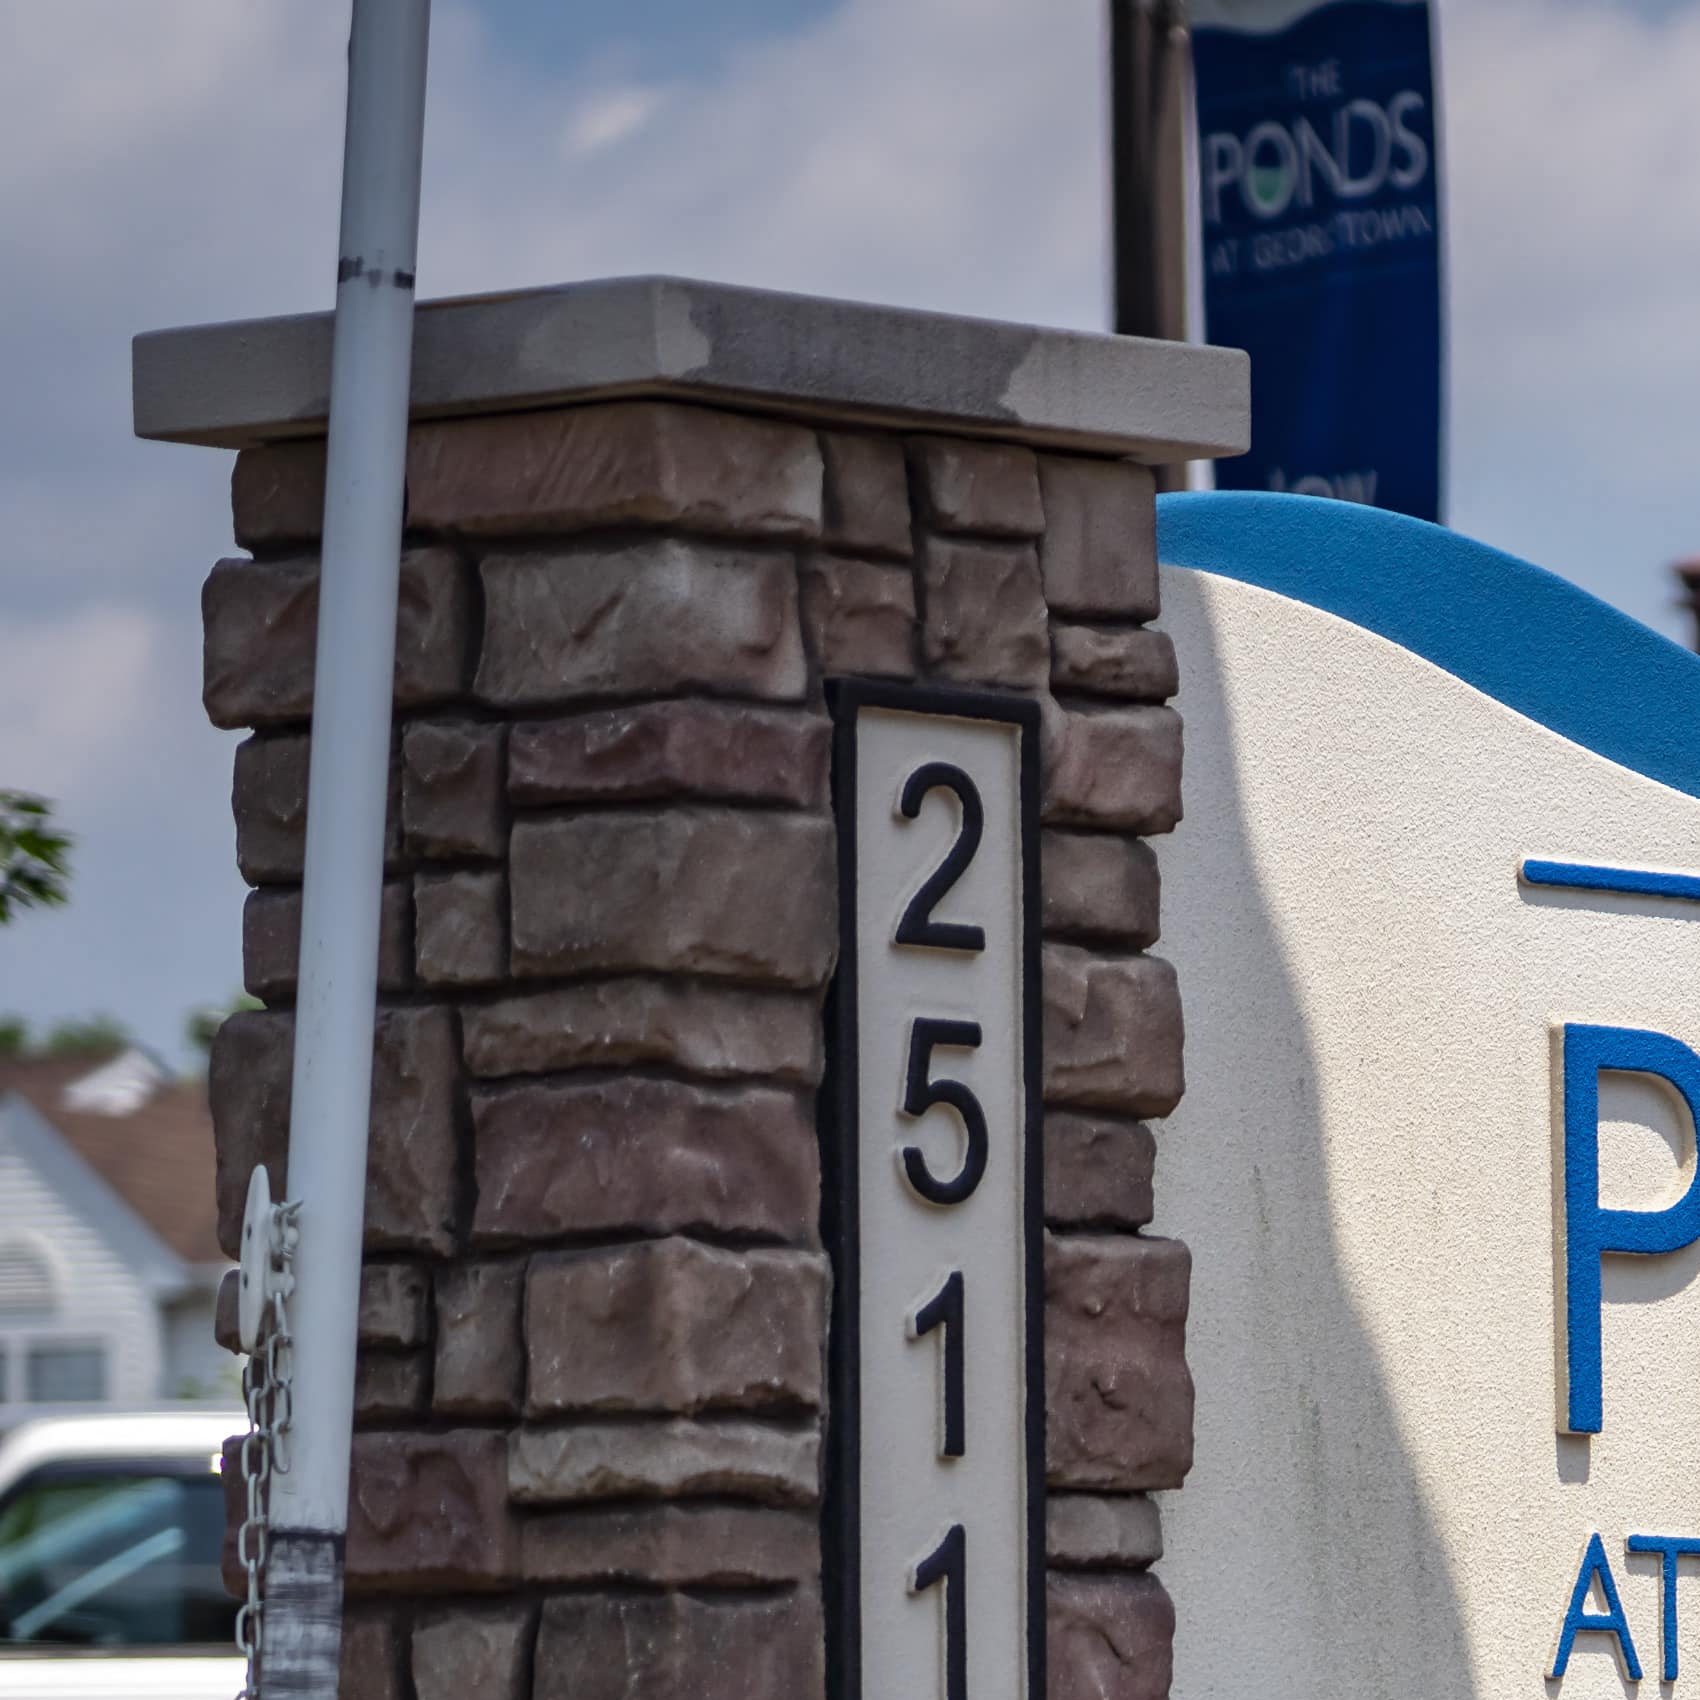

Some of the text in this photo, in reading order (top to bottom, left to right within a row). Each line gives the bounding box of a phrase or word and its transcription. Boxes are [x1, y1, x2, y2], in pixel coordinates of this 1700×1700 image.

[1289, 59, 1342, 99] THE
[1205, 91, 1429, 223] PONDS
[1253, 203, 1433, 269] GEORTOWN
